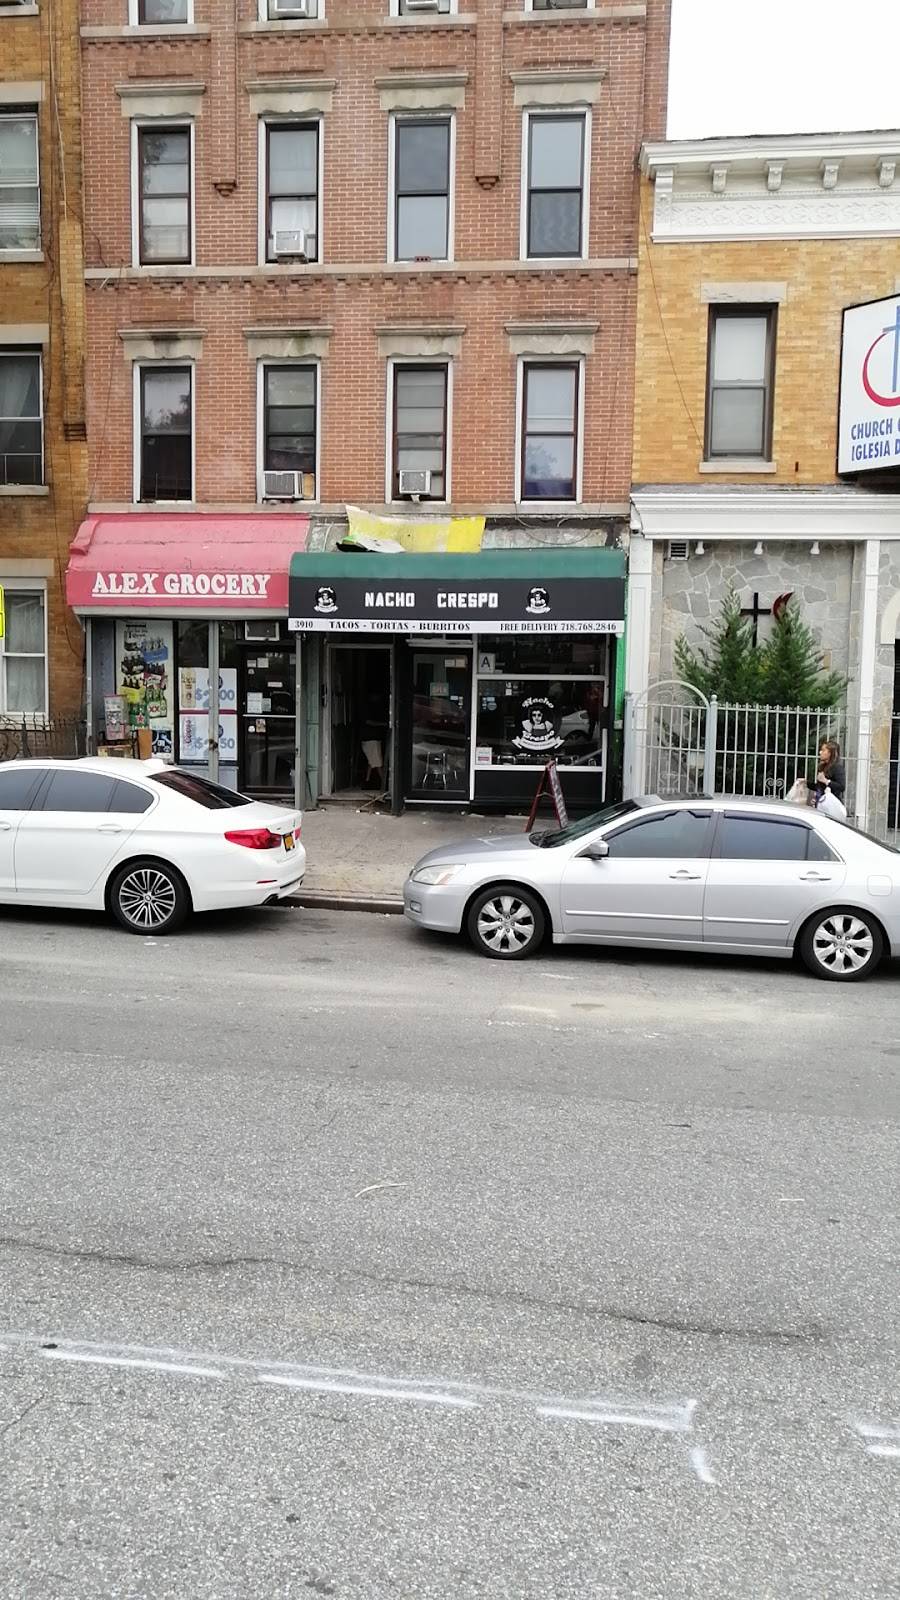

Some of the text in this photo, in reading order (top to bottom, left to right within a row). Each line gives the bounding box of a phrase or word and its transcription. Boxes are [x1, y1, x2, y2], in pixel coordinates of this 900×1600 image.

[851, 417, 893, 441] CHURCH
[851, 440, 890, 461] IGLESIA
[92, 572, 271, 595] ALEX GROCERY
[364, 592, 499, 609] NACHO CRESPO
[294, 620, 314, 629] 3910
[329, 621, 360, 630] TACOS
[371, 621, 409, 631] TORTAS
[419, 622, 471, 632] BURRITOS
[500, 623, 520, 632] FREE
[521, 623, 558, 632] DELIVERY
[560, 622, 617, 632] 718.768.2846
[480, 656, 491, 668] A
